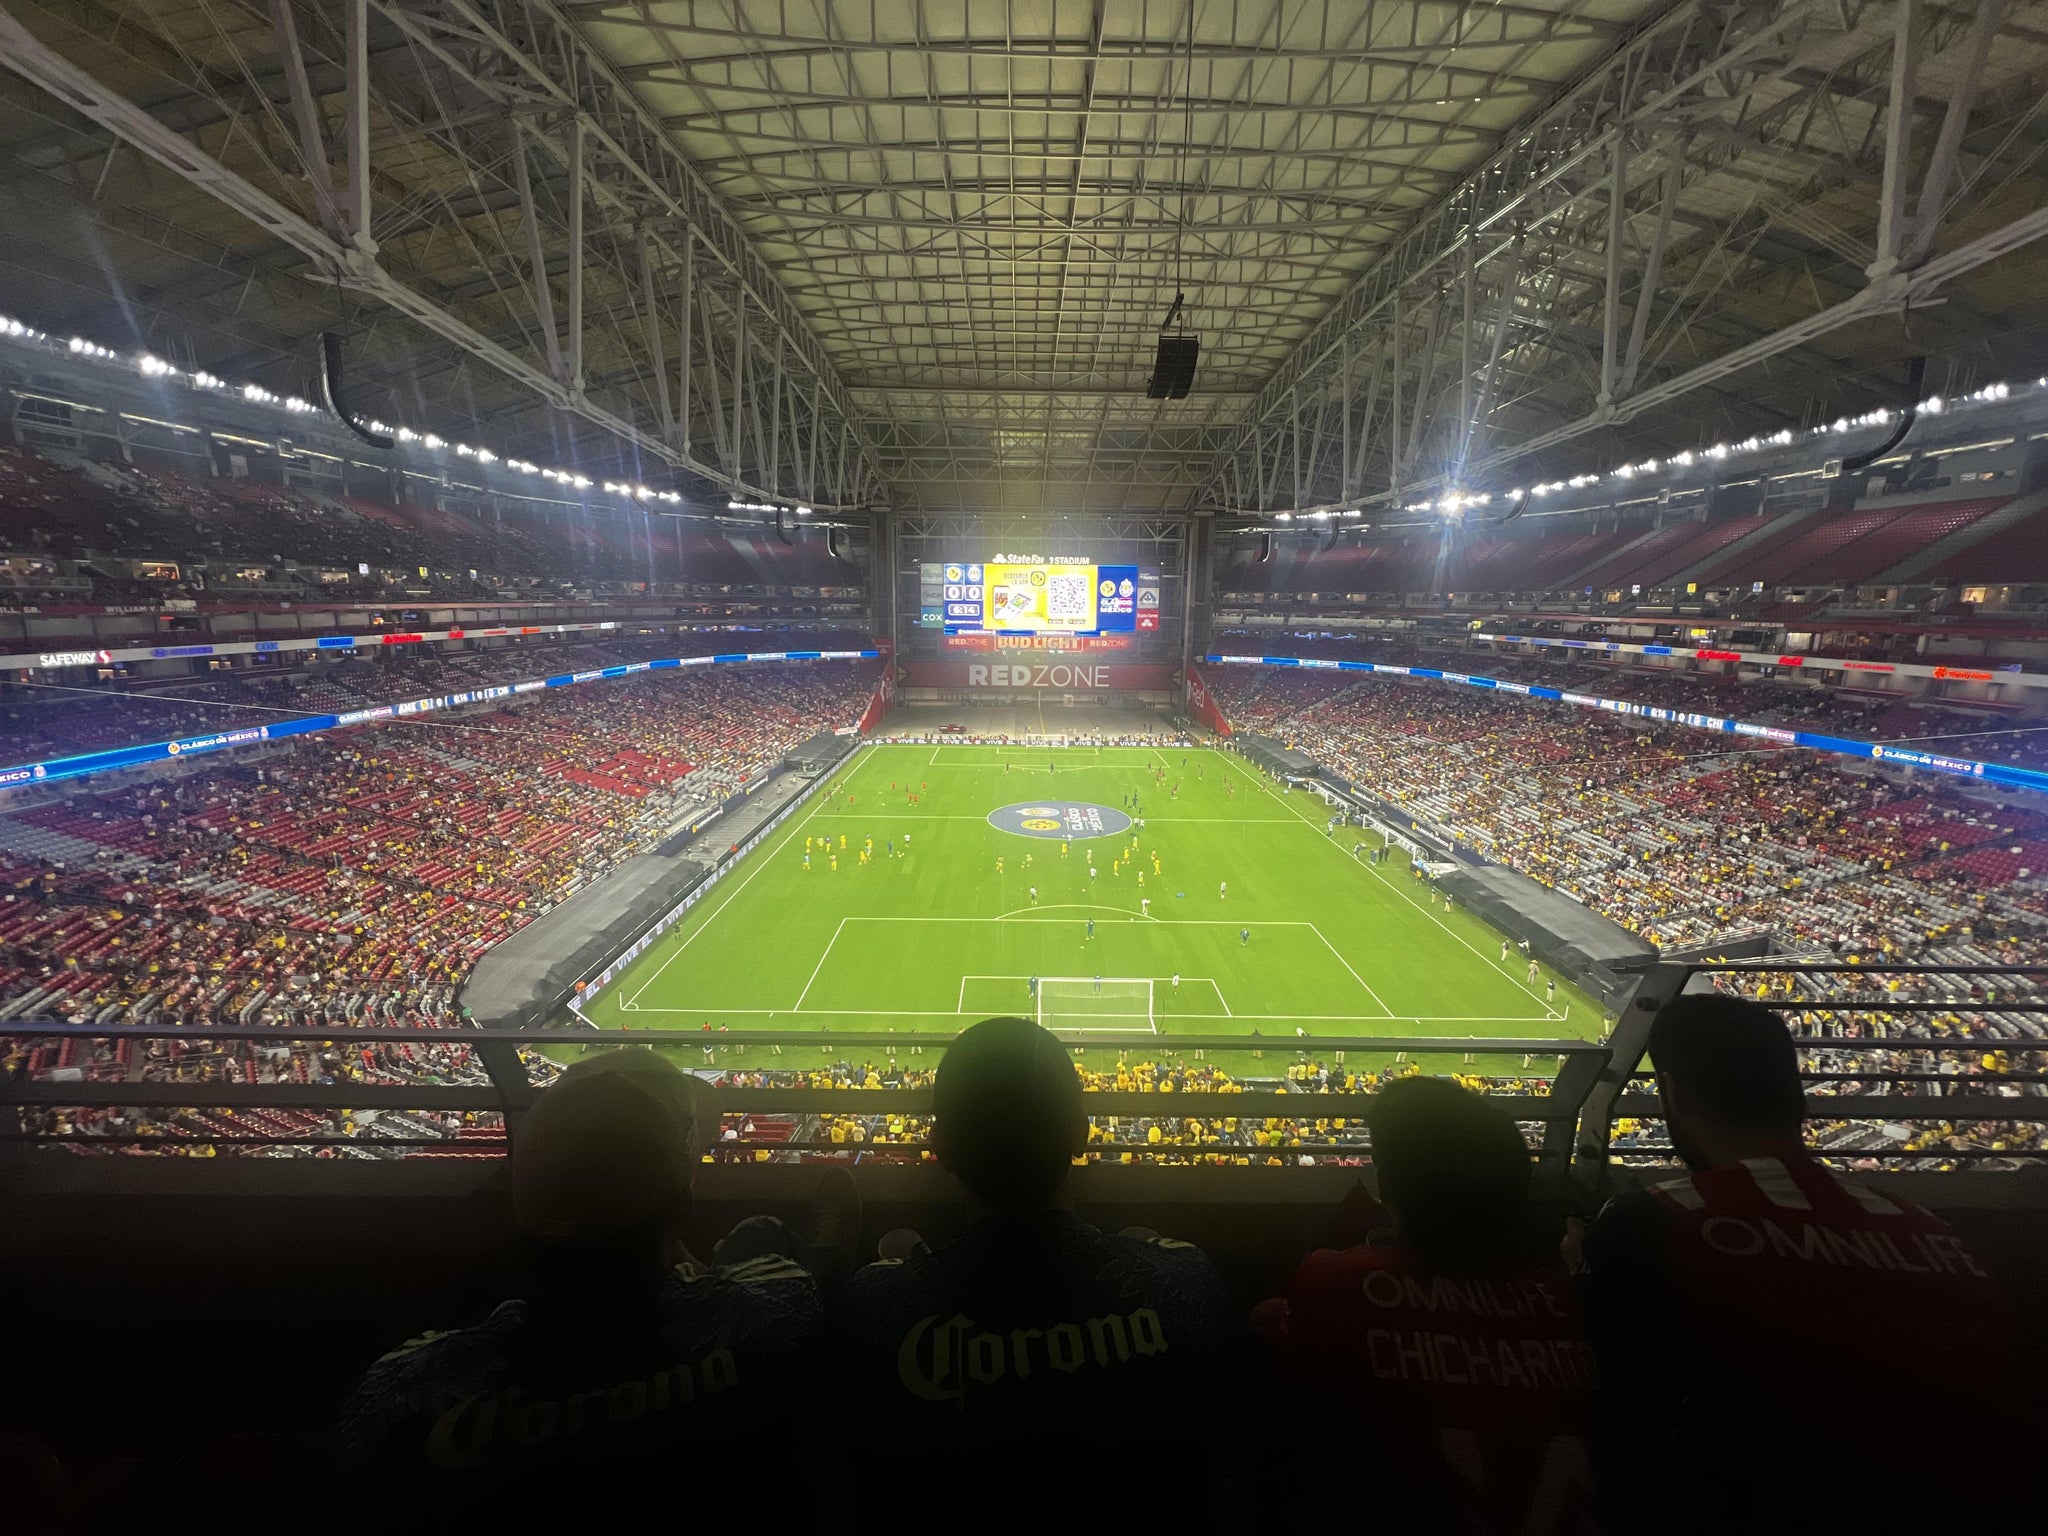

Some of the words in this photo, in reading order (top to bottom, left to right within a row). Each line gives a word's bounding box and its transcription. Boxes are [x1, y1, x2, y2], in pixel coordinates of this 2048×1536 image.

[1054, 556, 1090, 564] STADIUM
[948, 586, 960, 599] 0
[968, 586, 980, 599] 0
[997, 636, 1032, 649] BUD
[1034, 636, 1080, 649] LIGHT
[40, 652, 96, 666] SAFEWAY
[968, 664, 1110, 687] REDZONE
[1707, 717, 1723, 729] CHI
[181, 739, 215, 750] CLÁSICO
[228, 731, 259, 741] MÉXICO
[1884, 750, 1918, 762] CLÁSICO
[1919, 756, 1931, 764] DE
[1933, 758, 1971, 771] MÉXICO
[617, 947, 639, 970] VIVE
[641, 935, 652, 949] EL
[586, 983, 600, 1000] EL
[1700, 1216, 1989, 1278] OMNILIFE
[1362, 1269, 1568, 1320] OMNILIFE
[897, 1304, 1169, 1415] Corona
[425, 1347, 740, 1472] Corona
